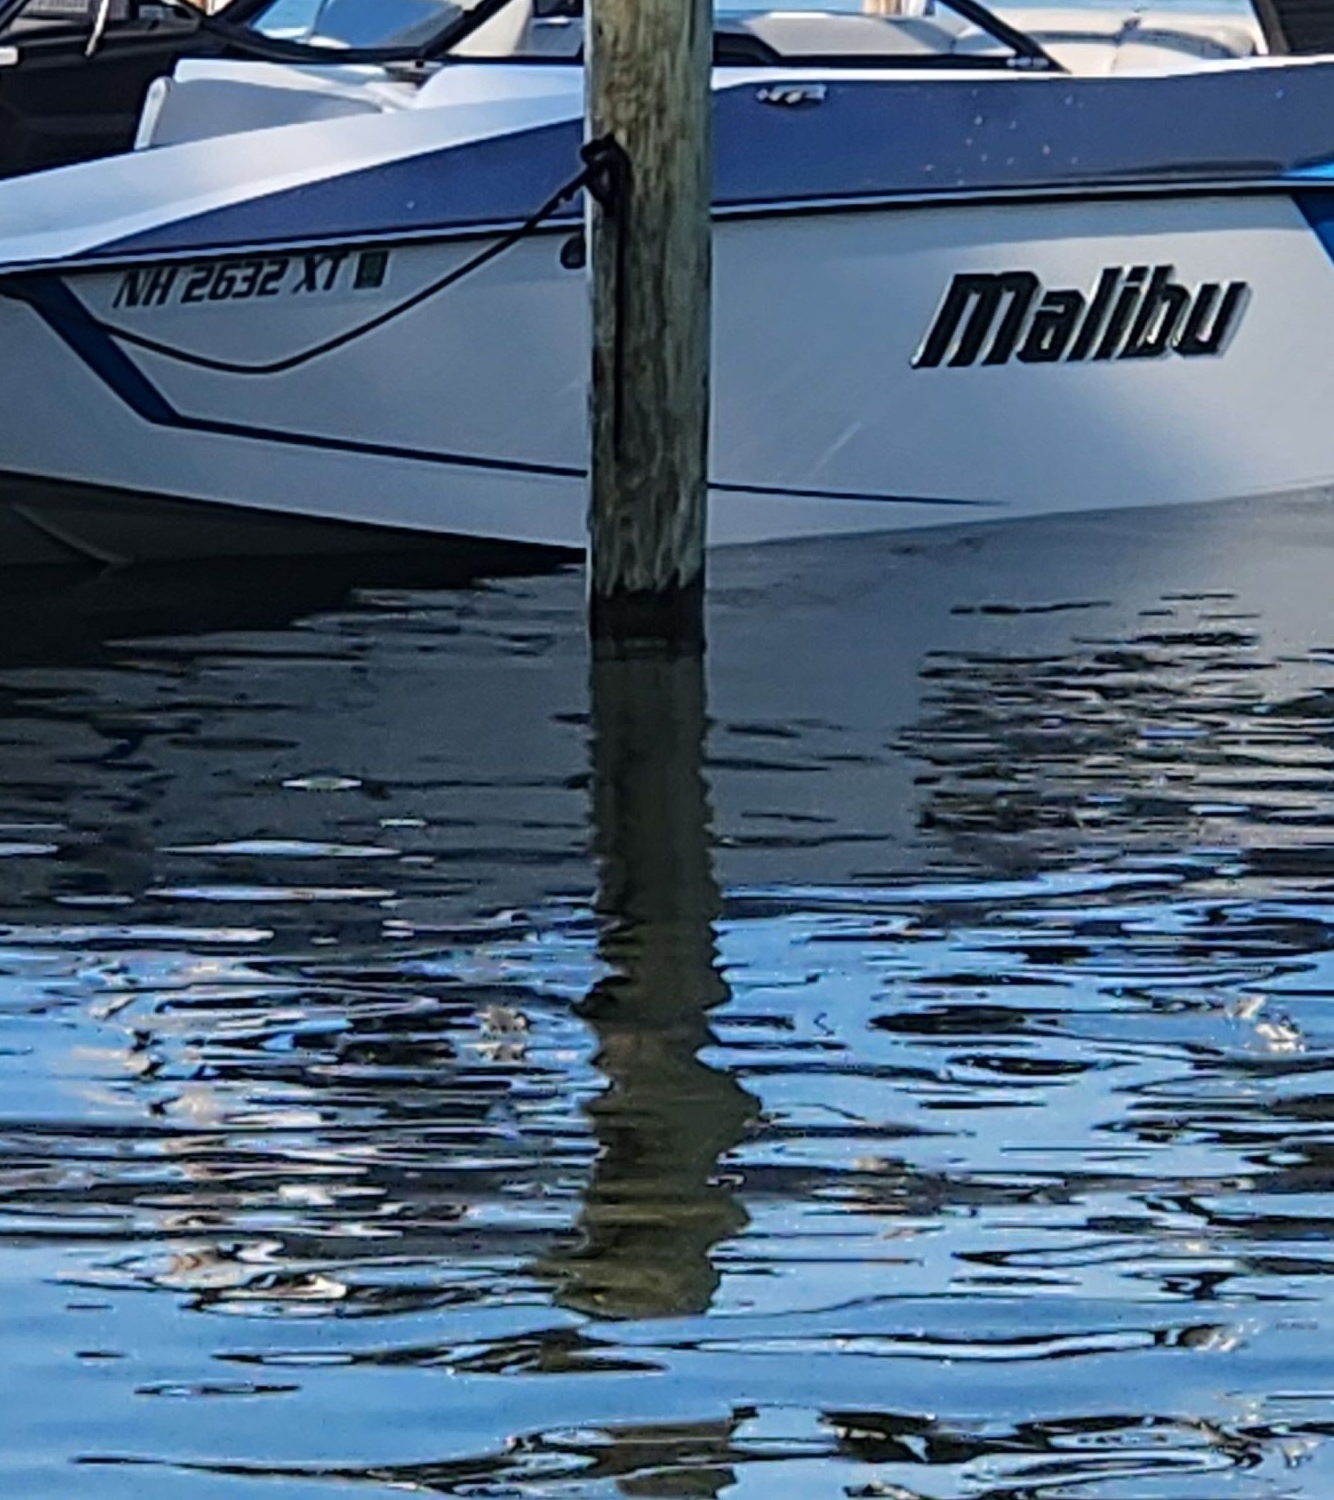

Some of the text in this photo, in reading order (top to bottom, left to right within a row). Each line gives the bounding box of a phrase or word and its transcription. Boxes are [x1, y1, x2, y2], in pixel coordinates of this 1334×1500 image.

[113, 252, 348, 308] NH 2632 XT
[911, 264, 1251, 370] Malibu
